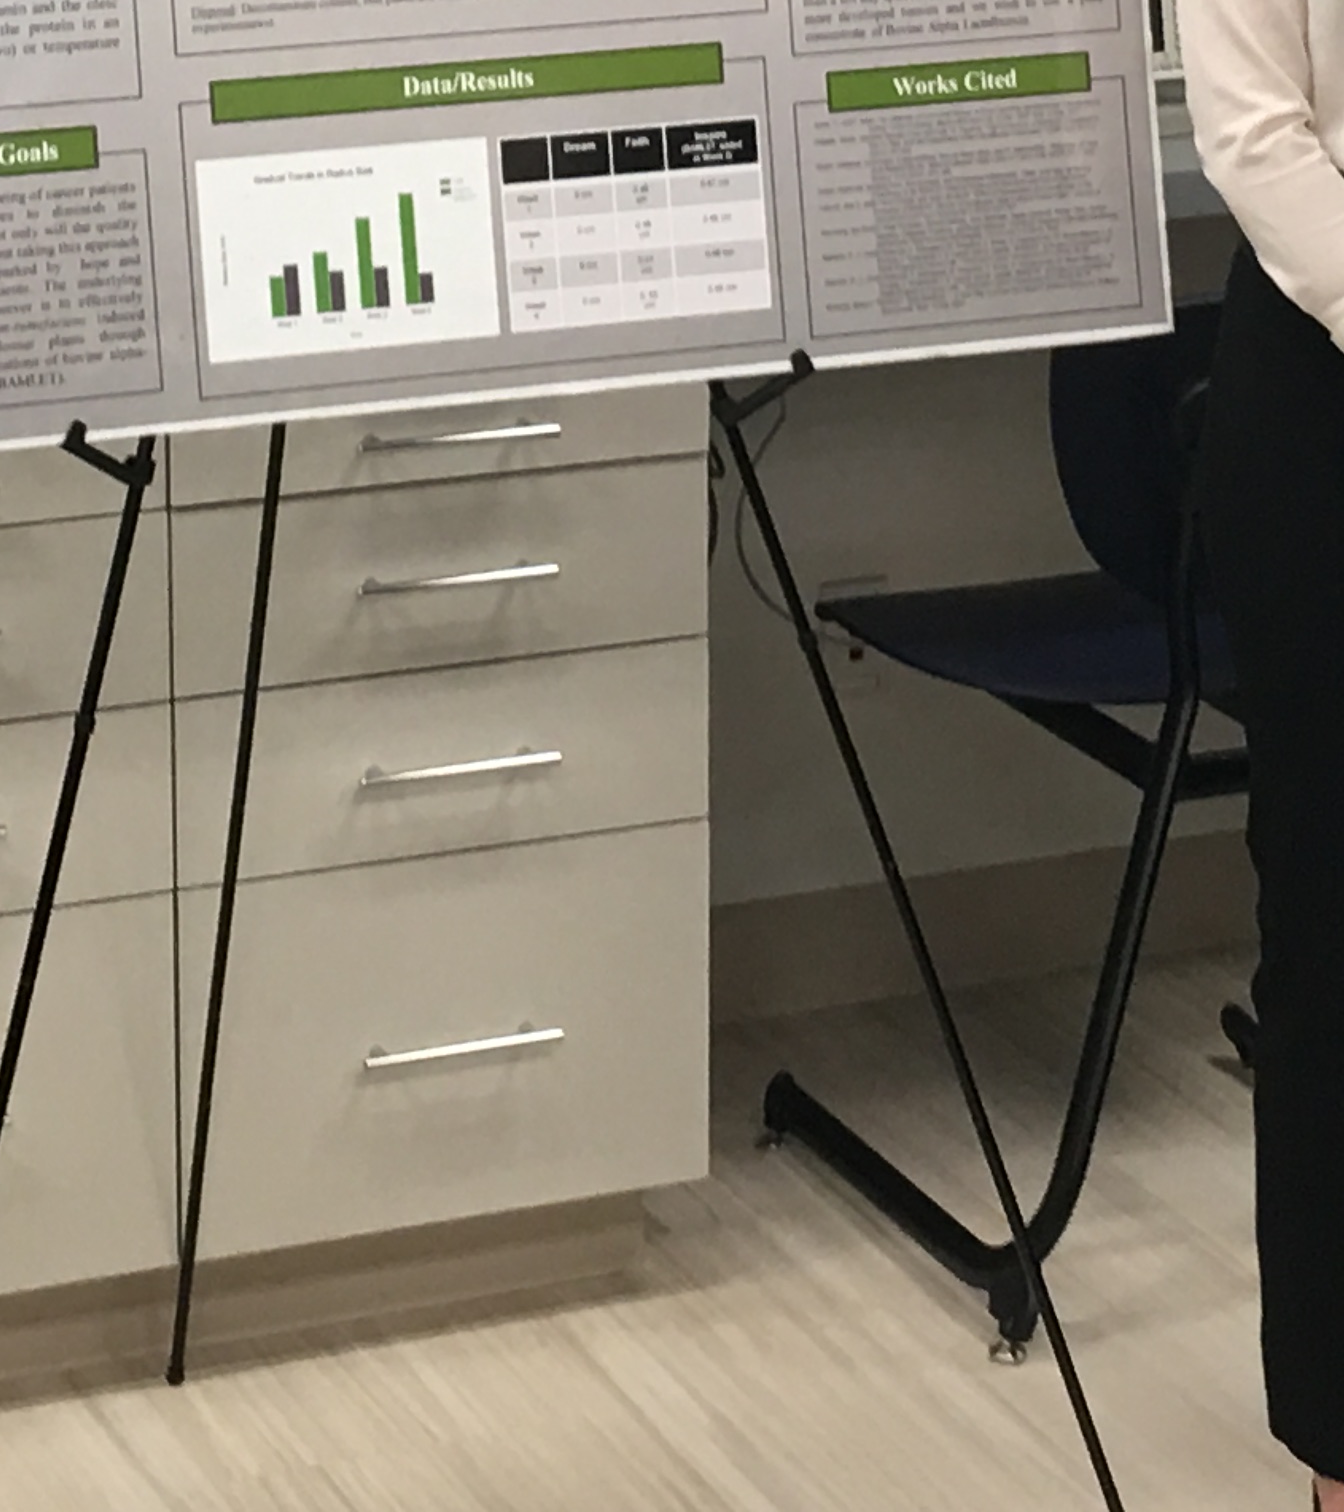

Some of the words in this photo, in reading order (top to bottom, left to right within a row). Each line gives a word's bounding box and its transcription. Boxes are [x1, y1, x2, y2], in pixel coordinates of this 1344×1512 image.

[403, 68, 534, 97] Data/Results
[893, 74, 958, 95] Works
[964, 68, 1017, 91] Cited
